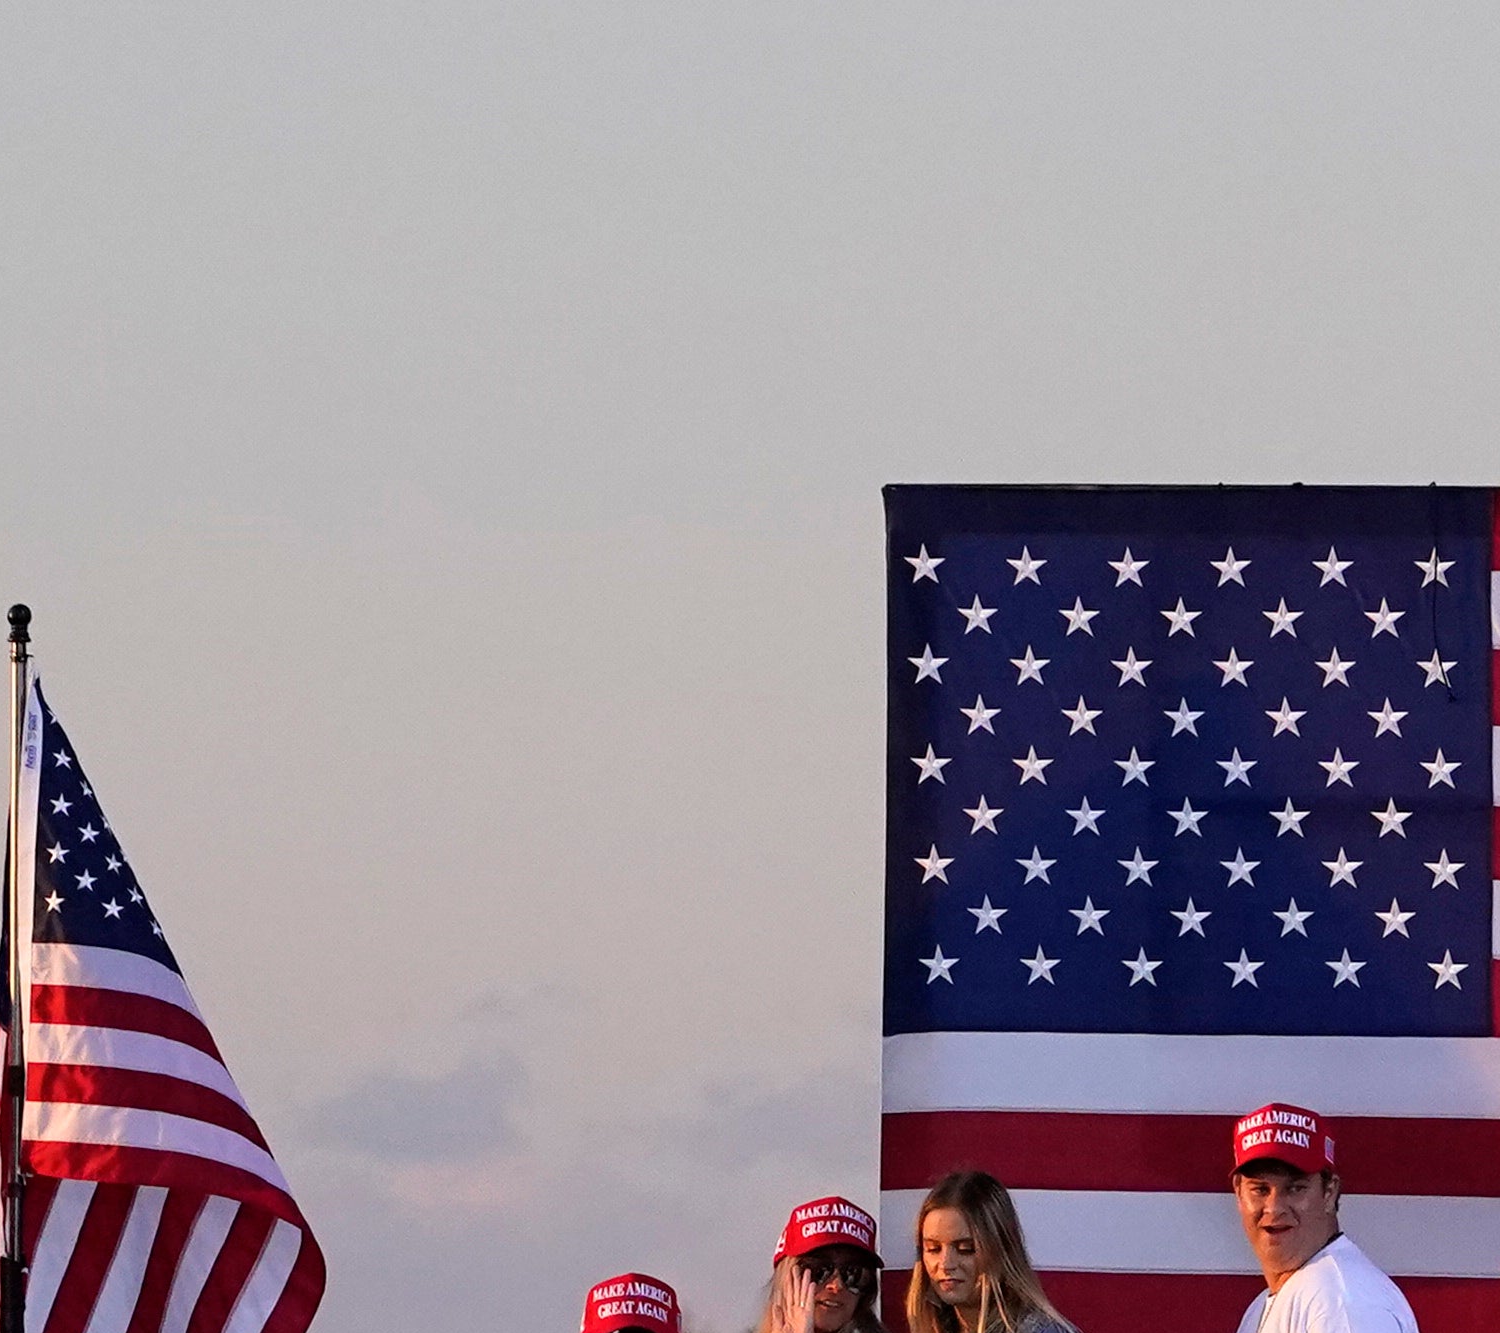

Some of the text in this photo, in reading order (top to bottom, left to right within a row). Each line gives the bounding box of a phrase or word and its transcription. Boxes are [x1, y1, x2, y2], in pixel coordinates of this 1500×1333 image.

[592, 1281, 671, 1304] MAKE AMERICA
[597, 1301, 668, 1321] GREAT AGAIN
